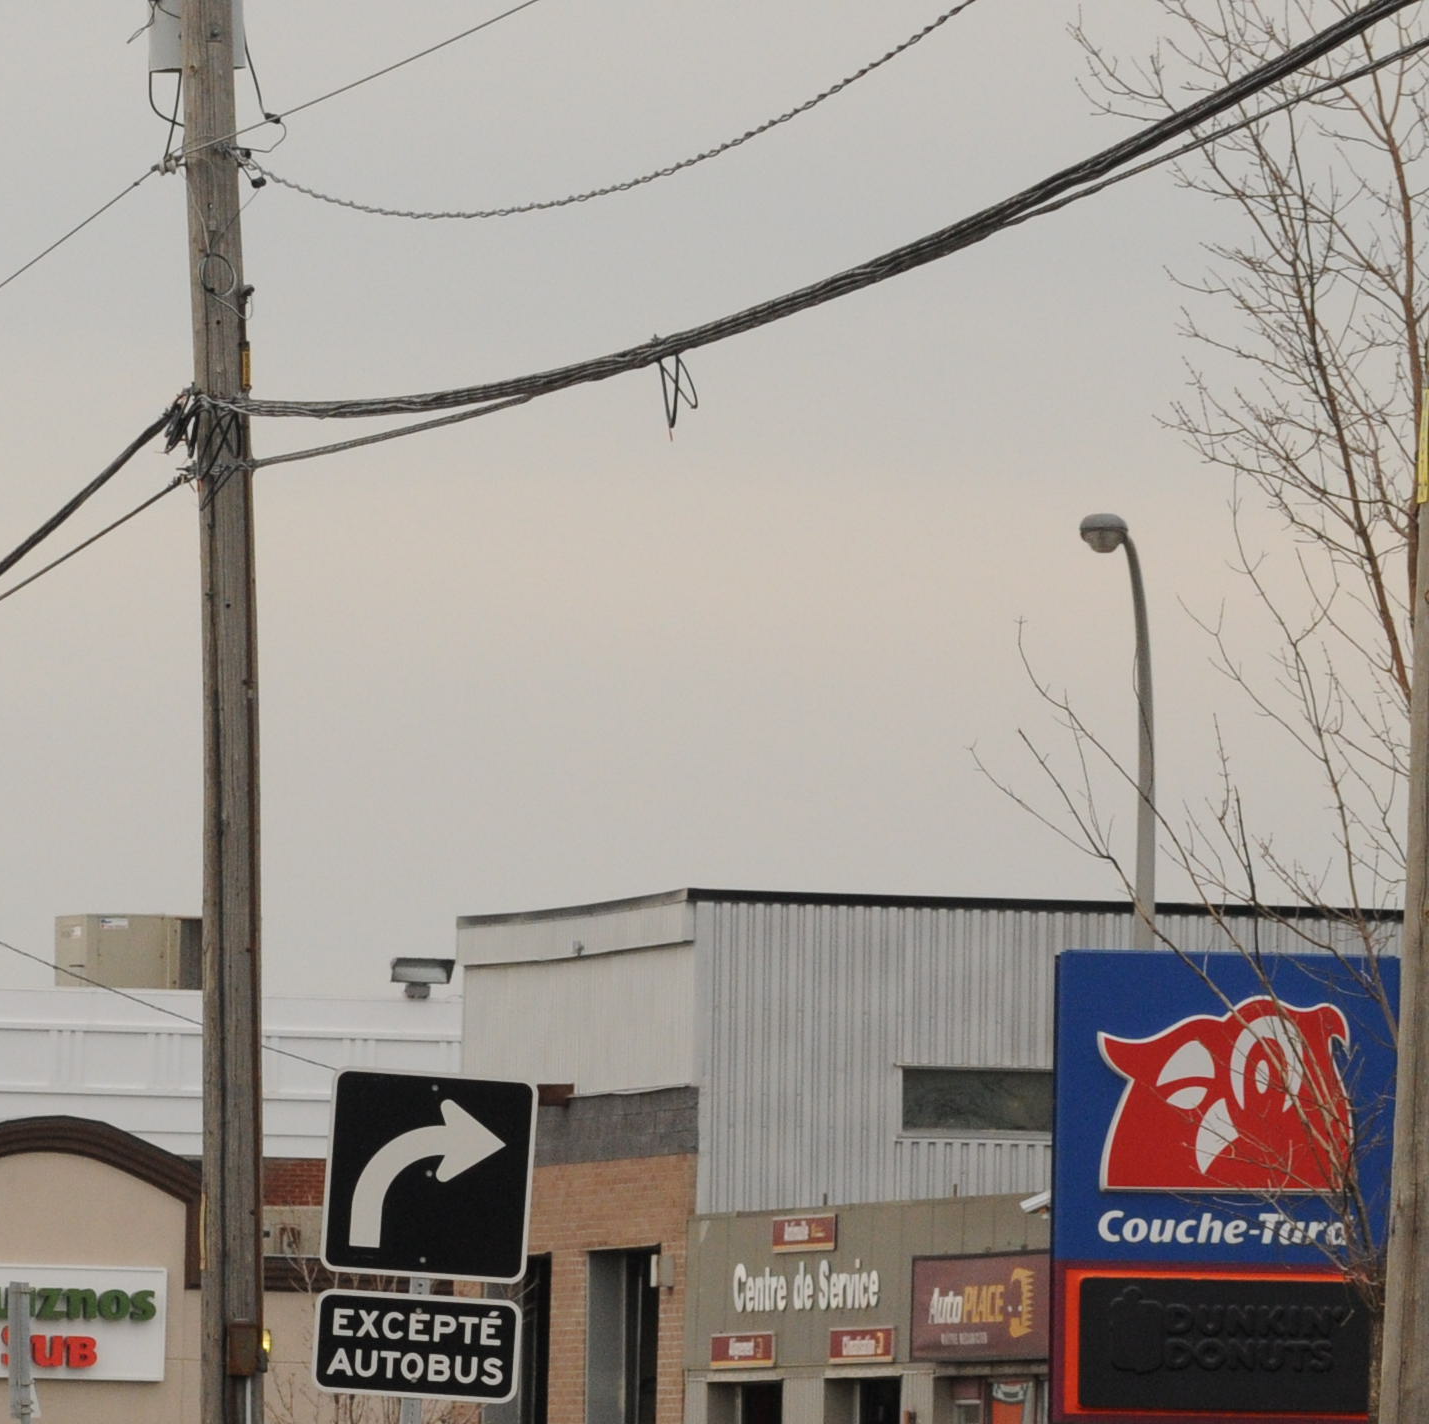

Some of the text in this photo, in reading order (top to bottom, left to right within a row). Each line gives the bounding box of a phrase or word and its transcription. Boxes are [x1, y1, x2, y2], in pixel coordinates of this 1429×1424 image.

[733, 1258, 879, 1313] Centre de Service
[332, 1307, 503, 1347] EXCEPTÉ
[1164, 1303, 1344, 1337] DUNKIN'
[326, 1347, 504, 1387] AUTOBUS
[1164, 1338, 1334, 1372] DONUTS
